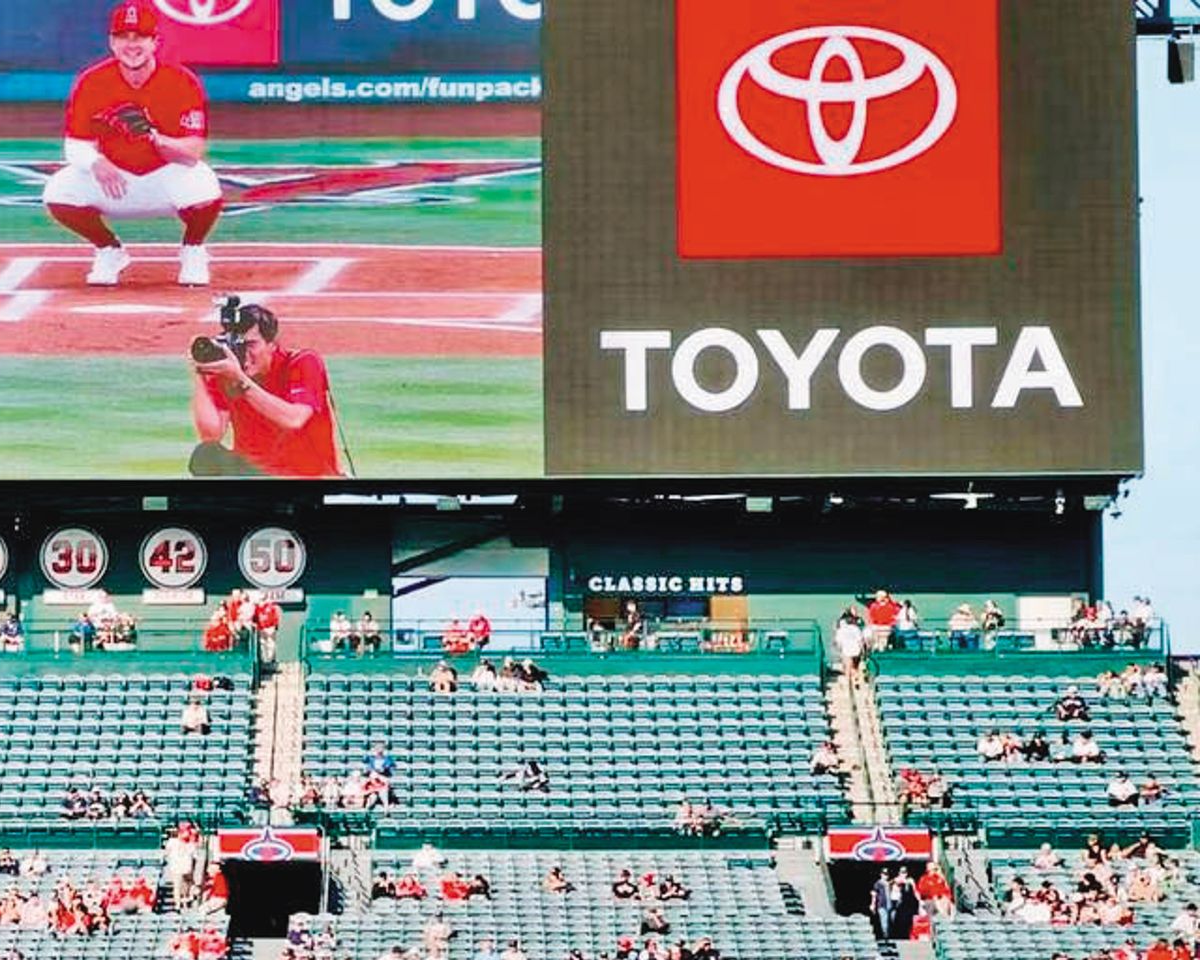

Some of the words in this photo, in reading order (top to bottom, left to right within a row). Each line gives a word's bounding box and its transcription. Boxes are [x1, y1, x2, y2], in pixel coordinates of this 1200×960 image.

[600, 325, 1084, 412] TOYOTA
[52, 540, 98, 574] 30
[150, 540, 195, 573] 42
[251, 539, 296, 573] 50
[587, 576, 683, 592] CLASSIC
[688, 576, 743, 592] HITS
